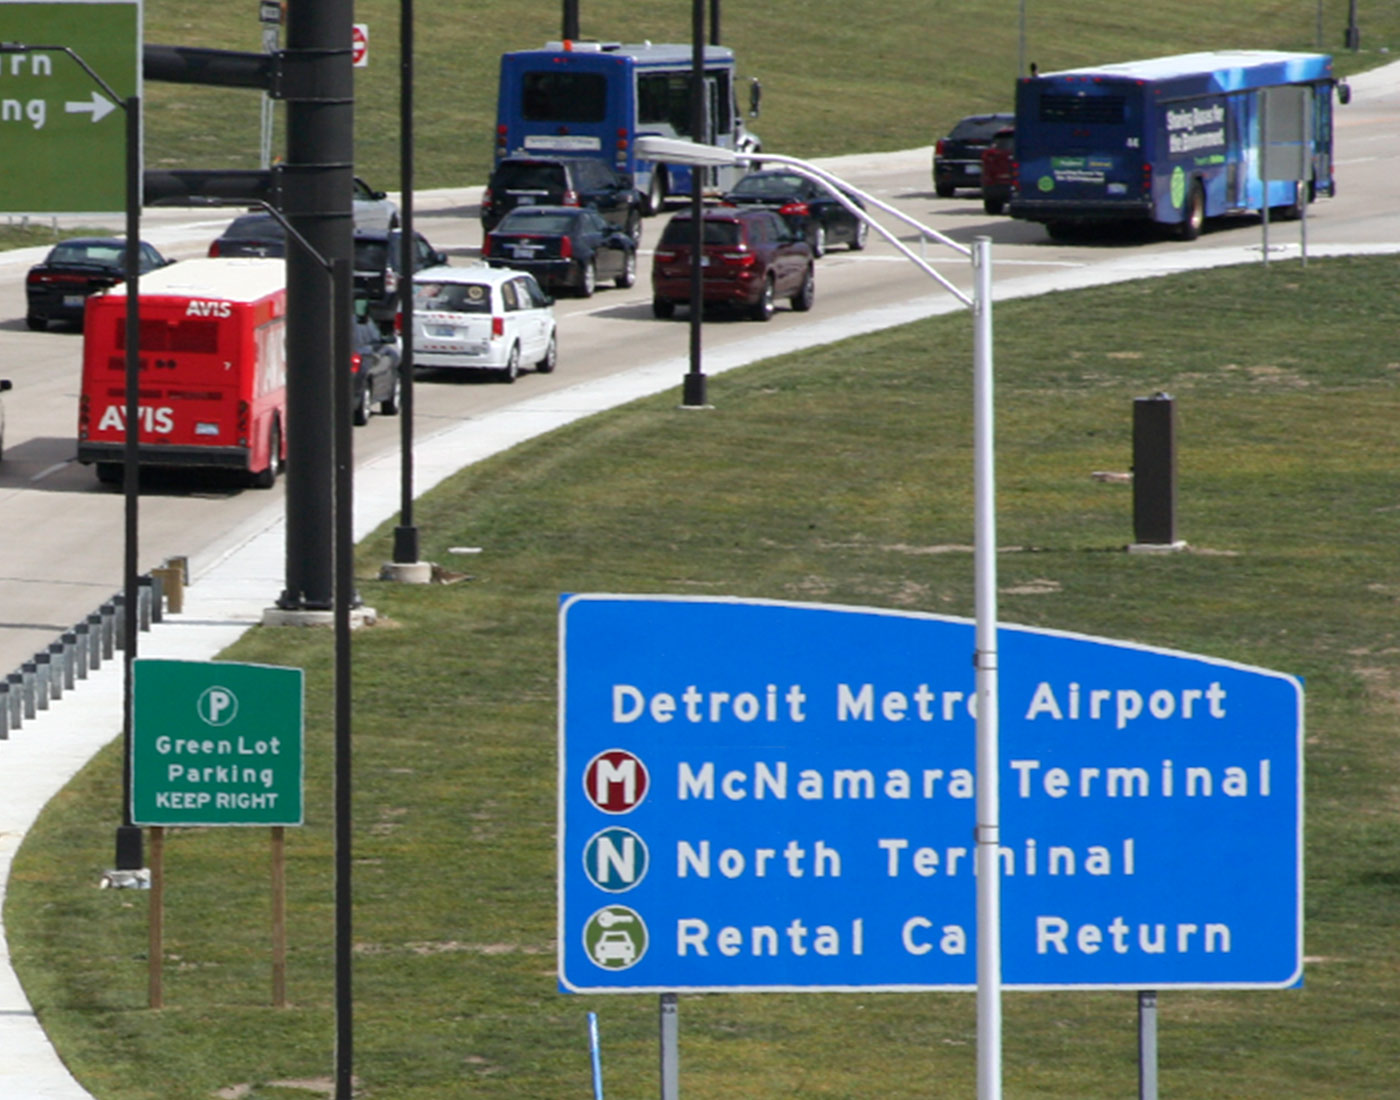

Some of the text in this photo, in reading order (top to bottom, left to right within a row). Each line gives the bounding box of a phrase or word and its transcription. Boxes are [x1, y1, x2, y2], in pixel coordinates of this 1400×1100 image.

[186, 300, 233, 318] AVIS
[613, 684, 806, 723] Detroit
[1026, 682, 1227, 729] Airport
[155, 735, 281, 755] Green Lot
[167, 764, 274, 788] Parking
[596, 759, 636, 804] M
[677, 759, 1270, 800] McNamara Terminal
[156, 792, 279, 809] KEEP RIGHT
[597, 837, 635, 883] N
[677, 840, 841, 878] North
[677, 916, 1231, 956] Rental Ca Return
